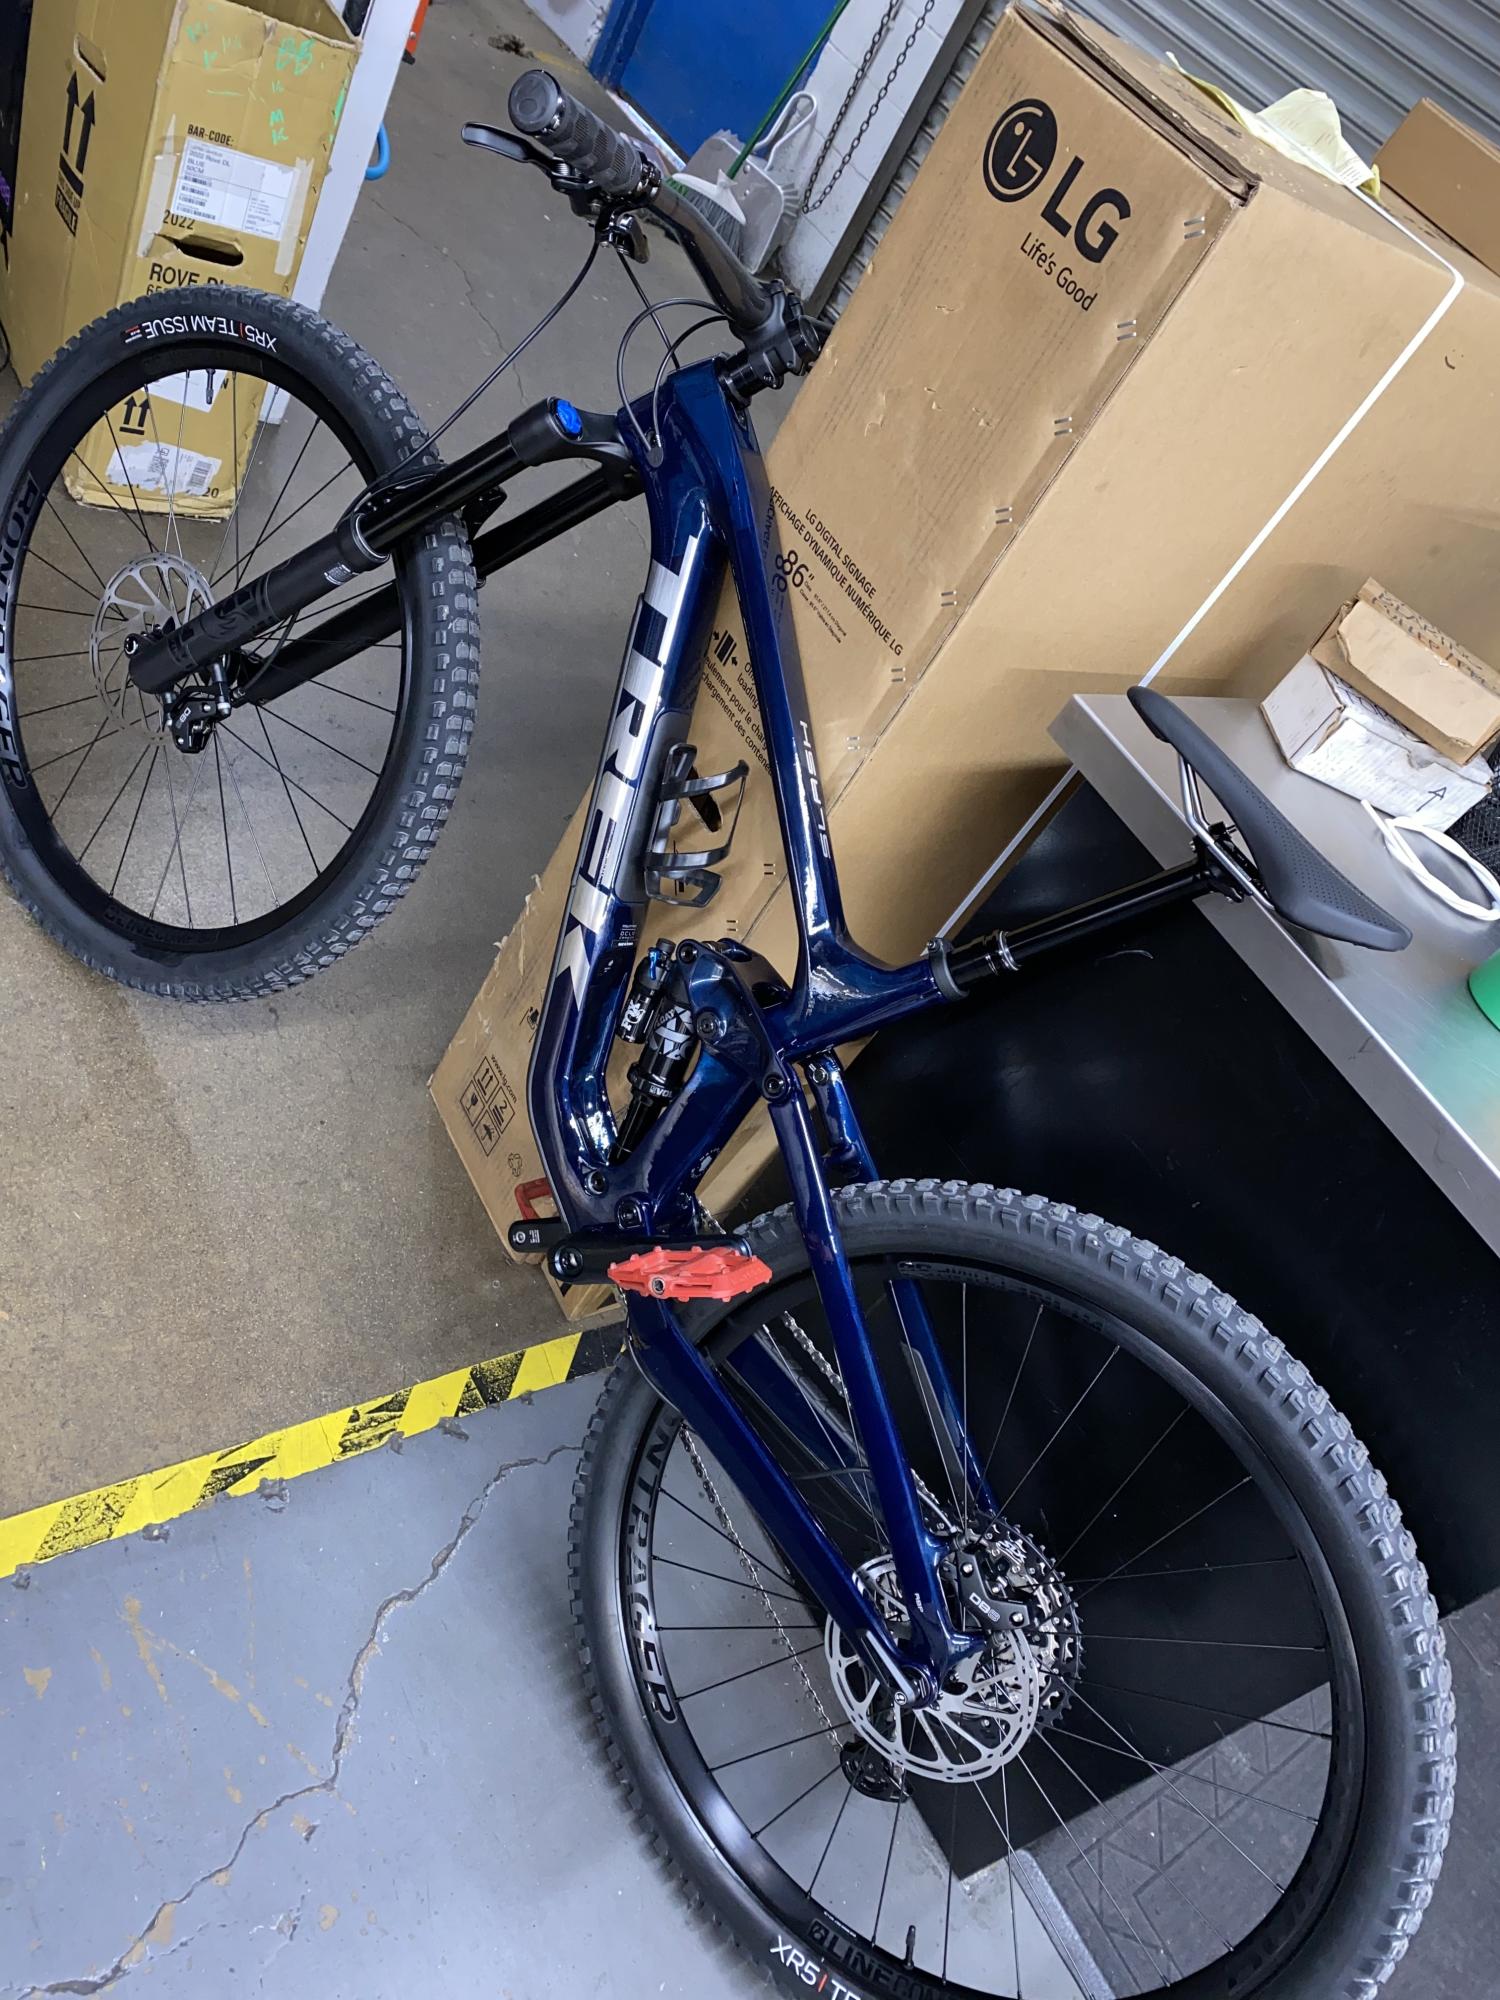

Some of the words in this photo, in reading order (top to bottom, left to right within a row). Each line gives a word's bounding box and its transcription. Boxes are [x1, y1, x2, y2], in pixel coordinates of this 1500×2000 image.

[187, 124, 234, 146] BAR-CODE:
[163, 208, 196, 231] 2022
[1040, 155, 1132, 264] LG
[149, 263, 200, 287] ROVE
[1020, 232, 1055, 276] Life's
[1056, 268, 1098, 312] Good
[142, 316, 188, 339] ISSUE
[190, 315, 239, 337] TEAM
[245, 324, 279, 353] XR5
[769, 485, 807, 535] AFFICHAGE
[803, 528, 848, 588] DYNAMIQUE
[844, 579, 892, 644] NUMÉRIQUE
[889, 637, 905, 657] LG
[805, 508, 818, 528] LG
[814, 521, 845, 559] DIGITAL
[842, 552, 878, 598] SIGNAGE
[704, 655, 732, 695] eulement
[727, 688, 747, 712] pour
[743, 710, 753, 726] le
[737, 676, 760, 709] loading
[733, 720, 748, 739] des
[558, 535, 699, 1010] TREK
[800, 720, 831, 859] SLASH
[620, 998, 648, 1029] FOX
[491, 1054, 518, 1103] www.lg.com
[770, 1935, 822, 1989] XR5
